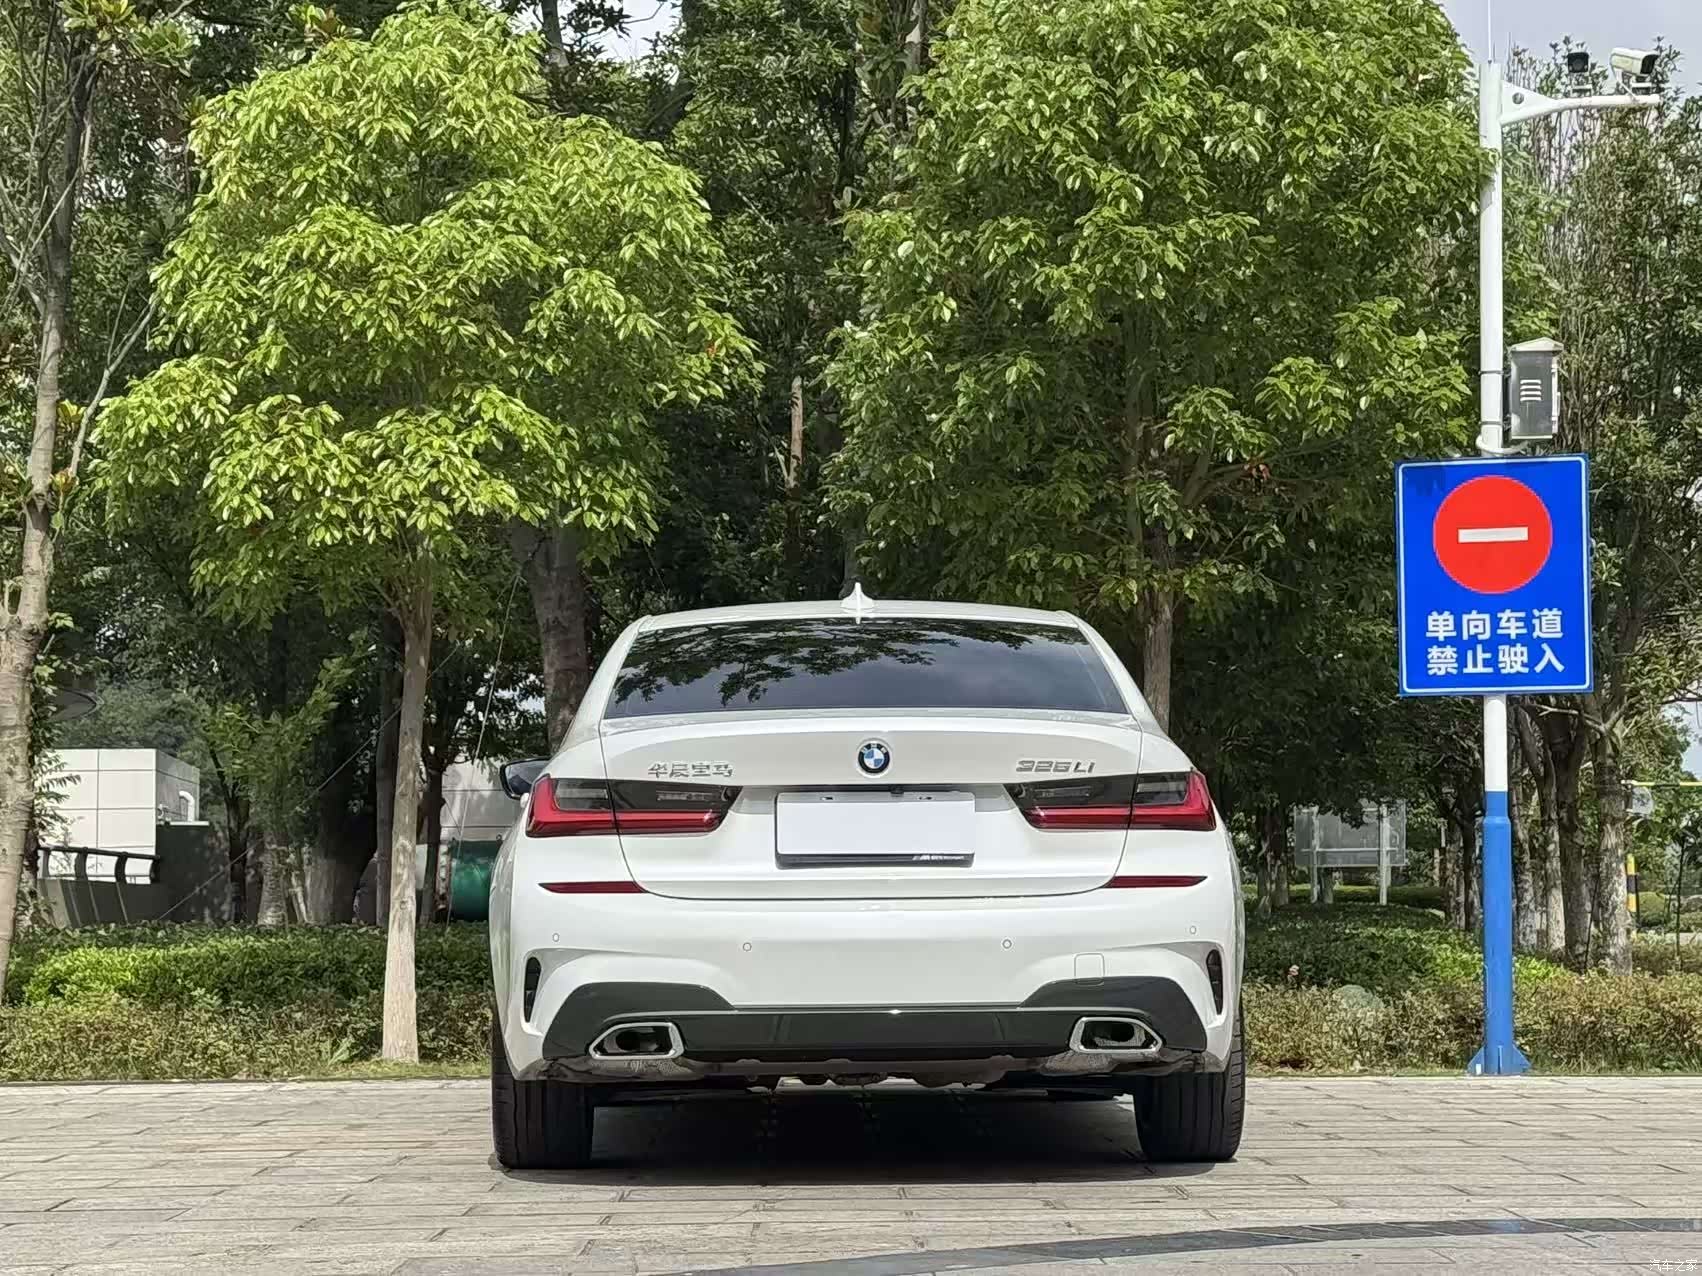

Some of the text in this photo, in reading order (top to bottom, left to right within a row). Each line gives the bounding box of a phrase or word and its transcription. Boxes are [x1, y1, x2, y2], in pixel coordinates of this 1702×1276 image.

[1425, 607, 1564, 642] 单向车道
[1426, 642, 1565, 676] 禁止驶入
